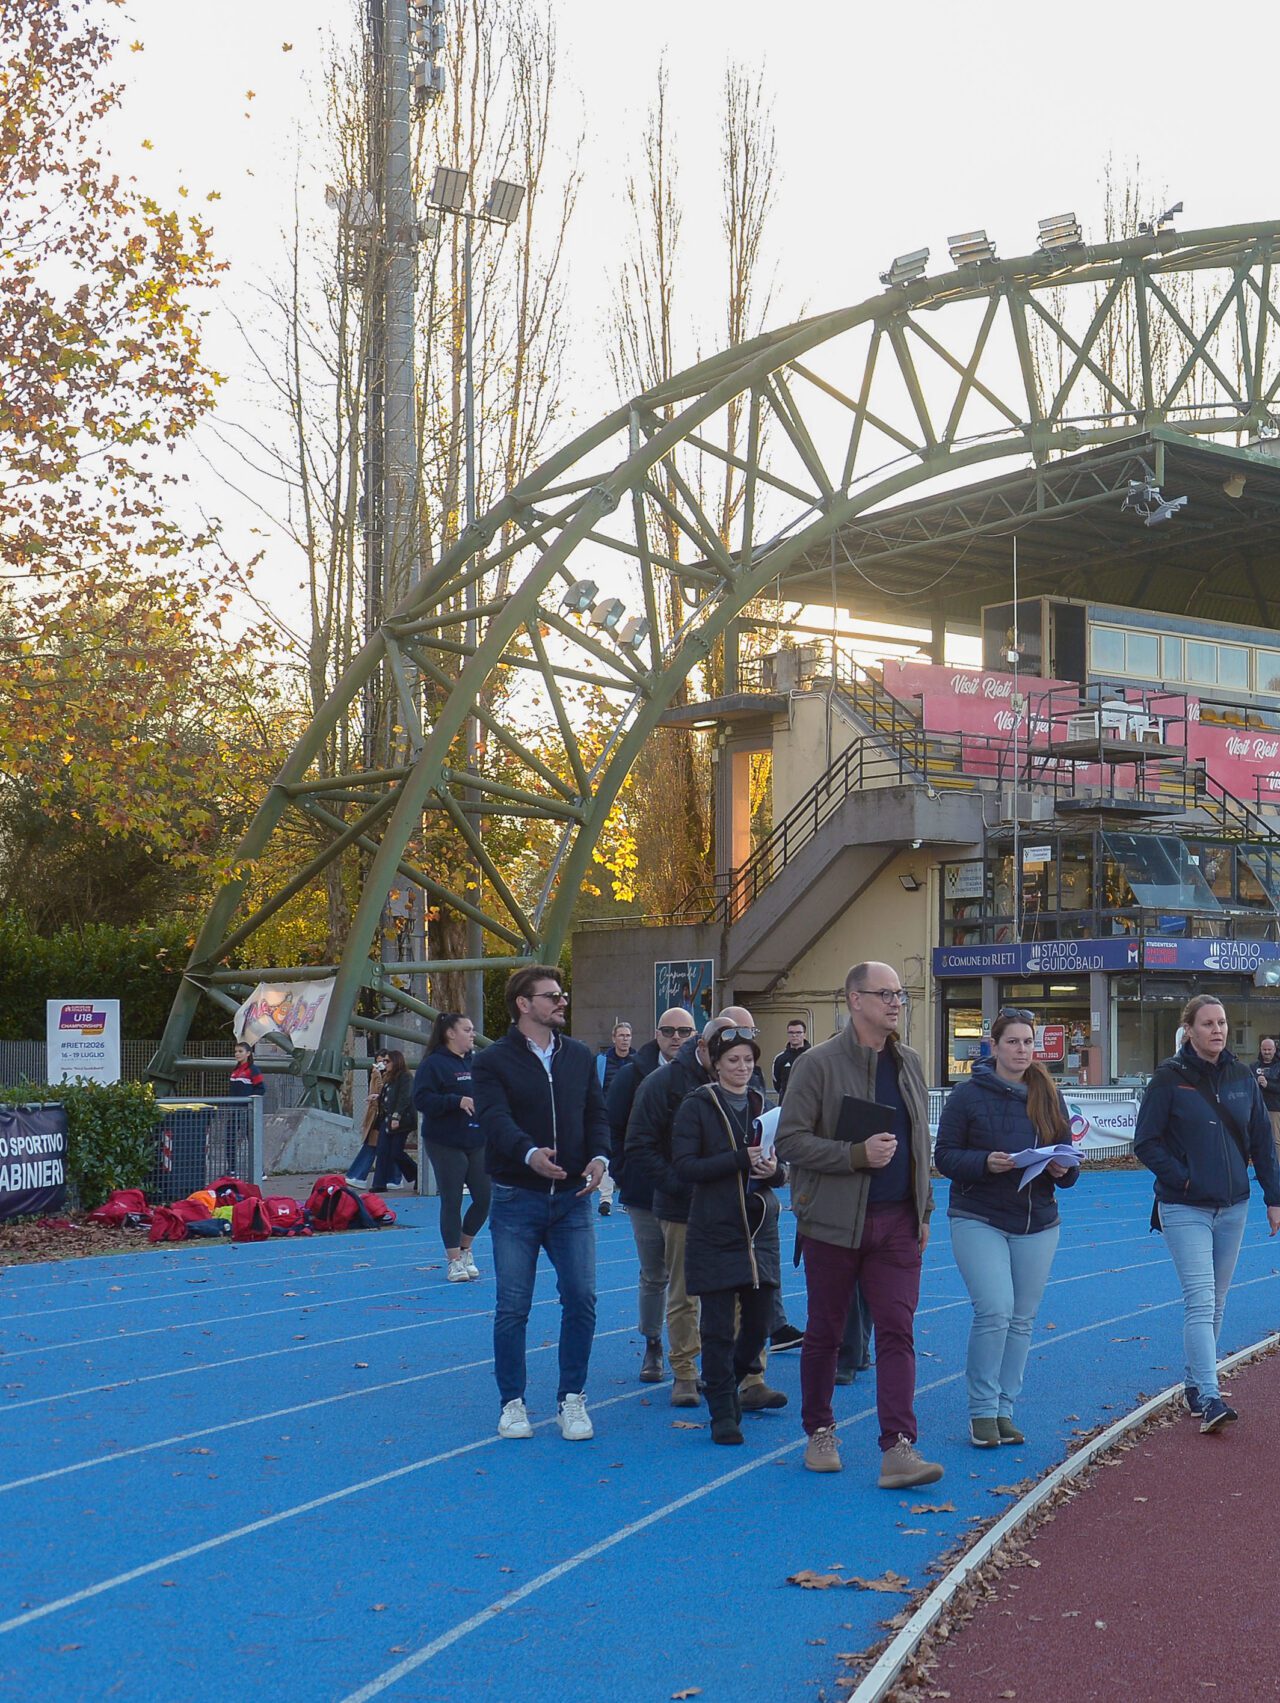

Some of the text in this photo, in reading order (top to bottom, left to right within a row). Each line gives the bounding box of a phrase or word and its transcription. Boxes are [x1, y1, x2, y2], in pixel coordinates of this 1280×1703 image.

[951, 674, 1012, 699] Visit Rieti
[1187, 703, 1200, 721] Vis
[1226, 736, 1280, 759] Visit Rieti
[1042, 943, 1078, 957] STADIO
[1220, 942, 1260, 957] STADIO
[992, 953, 1016, 965] RIETI
[1041, 956, 1104, 971] GUIDOBALDI
[73, 1013, 93, 1022] U18
[1092, 1114, 1136, 1128] TerreSabi
[10, 1133, 63, 1156] SPORTIVO
